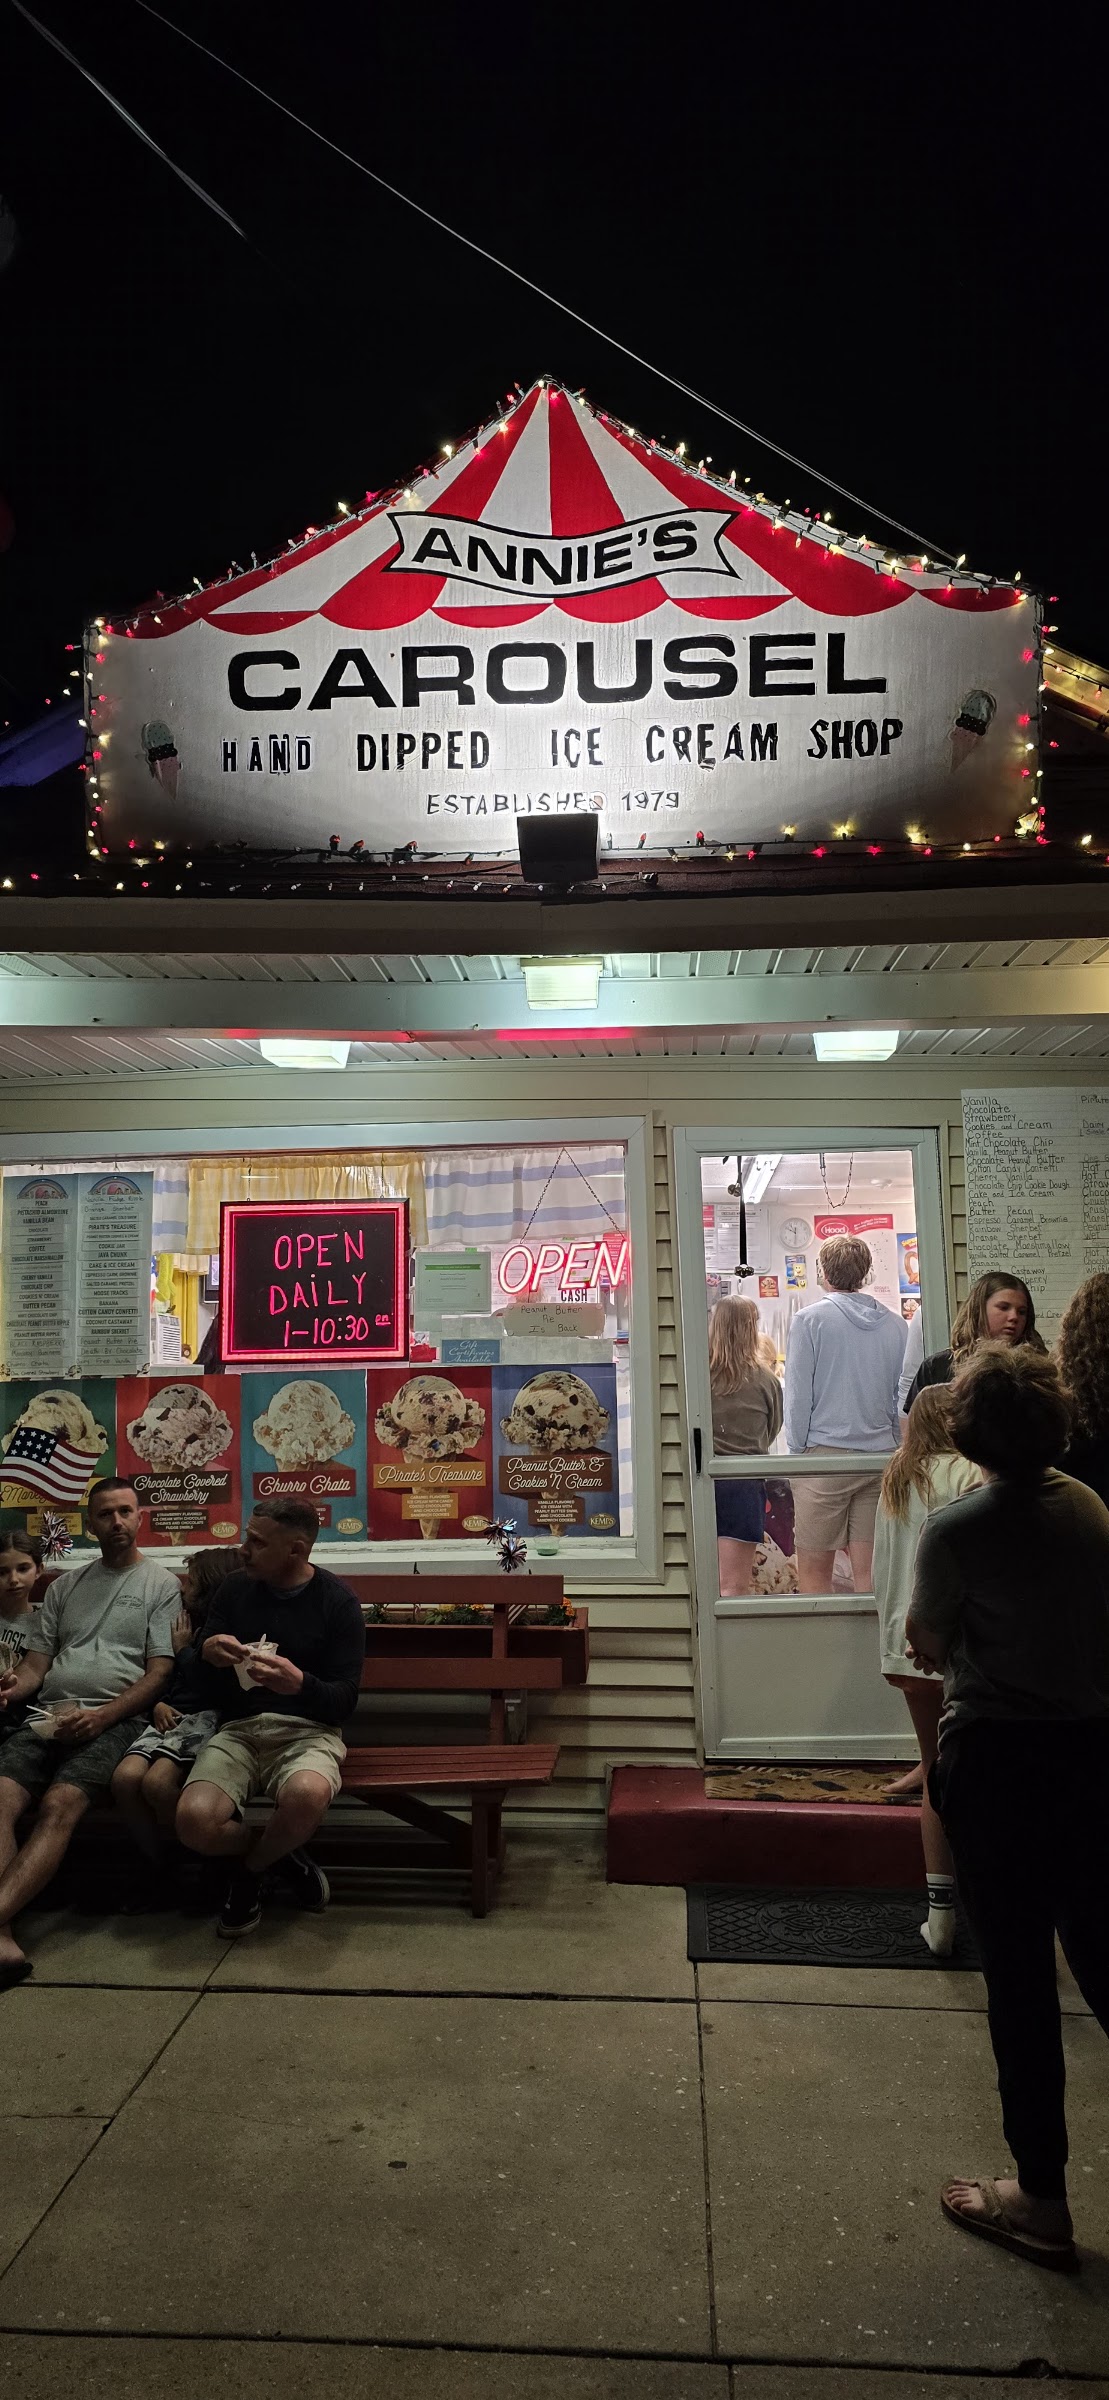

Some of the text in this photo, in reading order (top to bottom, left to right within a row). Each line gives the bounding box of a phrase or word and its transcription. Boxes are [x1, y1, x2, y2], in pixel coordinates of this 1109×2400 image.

[411, 519, 698, 585] ANNIE'S
[228, 632, 888, 711] CAROUSEL
[222, 718, 903, 773] HAND DIPPED ICE CREAM SHOP
[427, 790, 680, 815] ESTABLISHED 1979
[963, 1097, 1000, 1106] Vanilla
[963, 1105, 1011, 1114] Chocolate
[965, 1113, 1016, 1122] Strawberry
[965, 1122, 995, 1130] Cookies
[1017, 1120, 1052, 1129] Cream
[967, 1130, 1004, 1139] Coffee
[966, 1137, 1053, 1147] Mint Chocolate Chip
[967, 1155, 1004, 1165] Chocolate
[1037, 1154, 1065, 1164] Butter
[1049, 1179, 1070, 1190] Dough
[969, 1190, 987, 1198] Cake
[1009, 1189, 1024, 1197] Ice
[969, 1198, 994, 1207] Peach
[1007, 1206, 1033, 1215] Pecan
[824, 1226, 846, 1234] Hood
[273, 1229, 365, 1271] OPEN
[498, 1241, 628, 1294] OPEN
[1011, 1265, 1045, 1275] Castaway
[560, 1289, 588, 1302] CASH
[521, 1305, 583, 1315] Peanut Butter
[529, 1324, 578, 1334] Is Back
[459, 1340, 479, 1350] Gift
[448, 1347, 495, 1357] Certificates
[447, 1355, 491, 1363] Available
[506, 1457, 604, 1473] Peanut Butter &
[377, 1465, 483, 1484] Pirate's Treasure
[133, 1473, 228, 1490] Chocolate Covered
[258, 1474, 351, 1495] Churro Chata
[508, 1474, 548, 1490] Cookies
[565, 1473, 603, 1489] Cream
[150, 1488, 209, 1504] Strawberry
